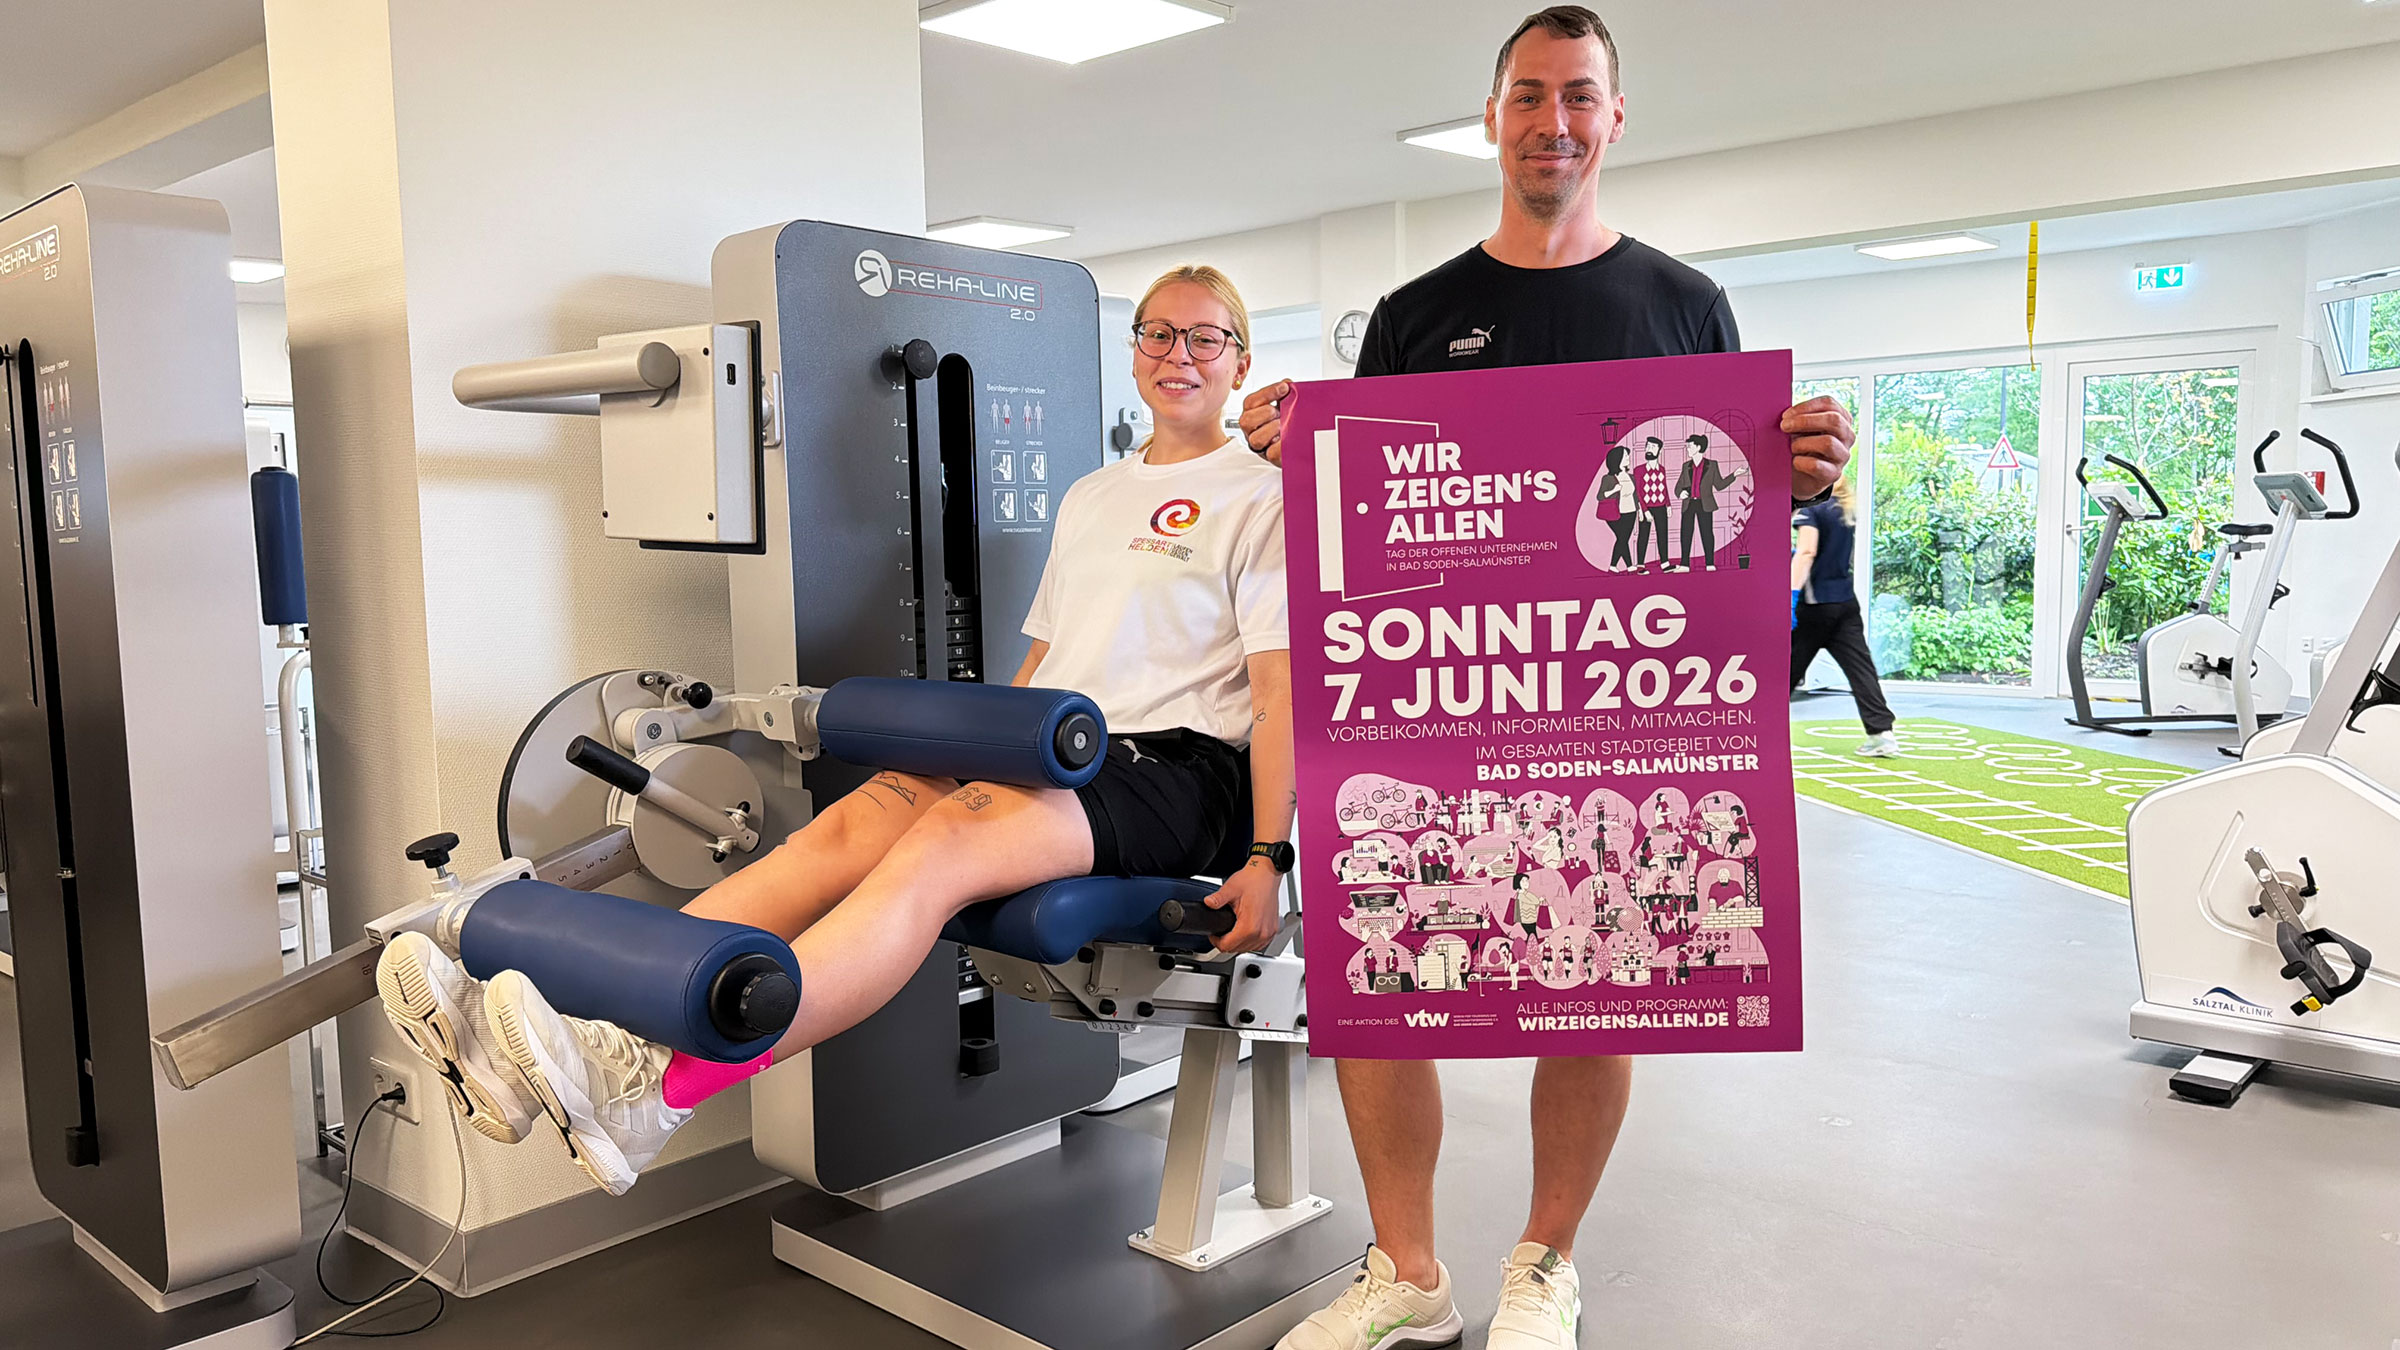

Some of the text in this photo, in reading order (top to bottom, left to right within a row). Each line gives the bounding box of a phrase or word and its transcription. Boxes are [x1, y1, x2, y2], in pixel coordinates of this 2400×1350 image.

[898, 268, 1035, 303] REHA-LINE
[1010, 308, 1036, 322] 2.0
[1449, 336, 1485, 352] PUMA
[892, 382, 897, 390] 2
[1382, 442, 1462, 475] WIR
[896, 491, 900, 499] 5
[897, 527, 902, 535] 6
[1385, 508, 1503, 544] ALLEN
[1128, 543, 1169, 555] HELDEN
[1386, 541, 1558, 559] TAG DER OFFENEN UNTERNEHMEN
[1386, 555, 1531, 572] IN BAD SODEN-SALMÜNSTER
[1323, 594, 1687, 663] SONNTAG
[900, 634, 905, 642] 9
[900, 669, 908, 677] 10
[1324, 654, 1758, 721] 7. JUNI 2026
[1326, 708, 1757, 743] VORBEIKOMMEN, INFORMIEREN, MITMACHEN.
[1475, 734, 1758, 761] IM GESAMTEN STADTGEBIET VON
[1476, 752, 1759, 782] BAD SODEN-SALMÜNSTER
[1516, 998, 1729, 1014] ALLE INFOS UND PROGRAMM:
[2192, 997, 2274, 1018] SALZTAL KLINIK
[1337, 1017, 1399, 1026] EINE AKTION DES
[1403, 1008, 1450, 1027] vtw
[1517, 1012, 1729, 1031] WIRZEIGENSALLEN.DE
